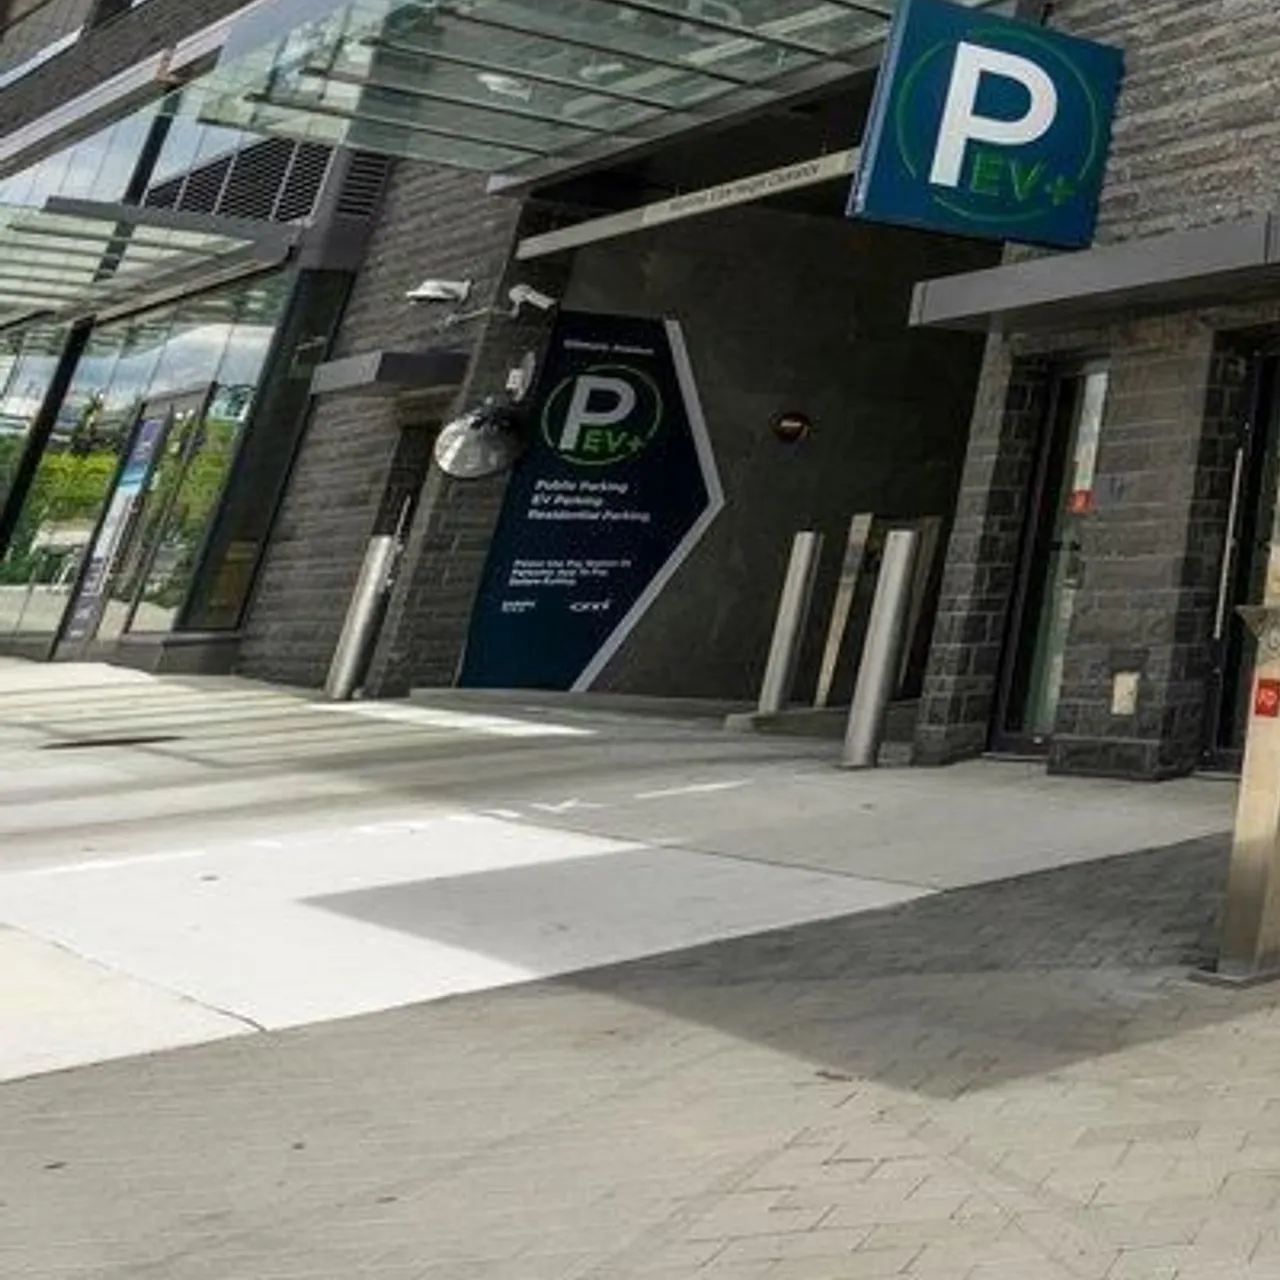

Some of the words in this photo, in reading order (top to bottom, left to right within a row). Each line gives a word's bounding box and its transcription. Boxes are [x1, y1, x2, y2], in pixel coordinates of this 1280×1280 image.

[928, 41, 1058, 187] P
[558, 374, 637, 451] P
[534, 480, 577, 491] Public
[580, 480, 628, 494] Parking
